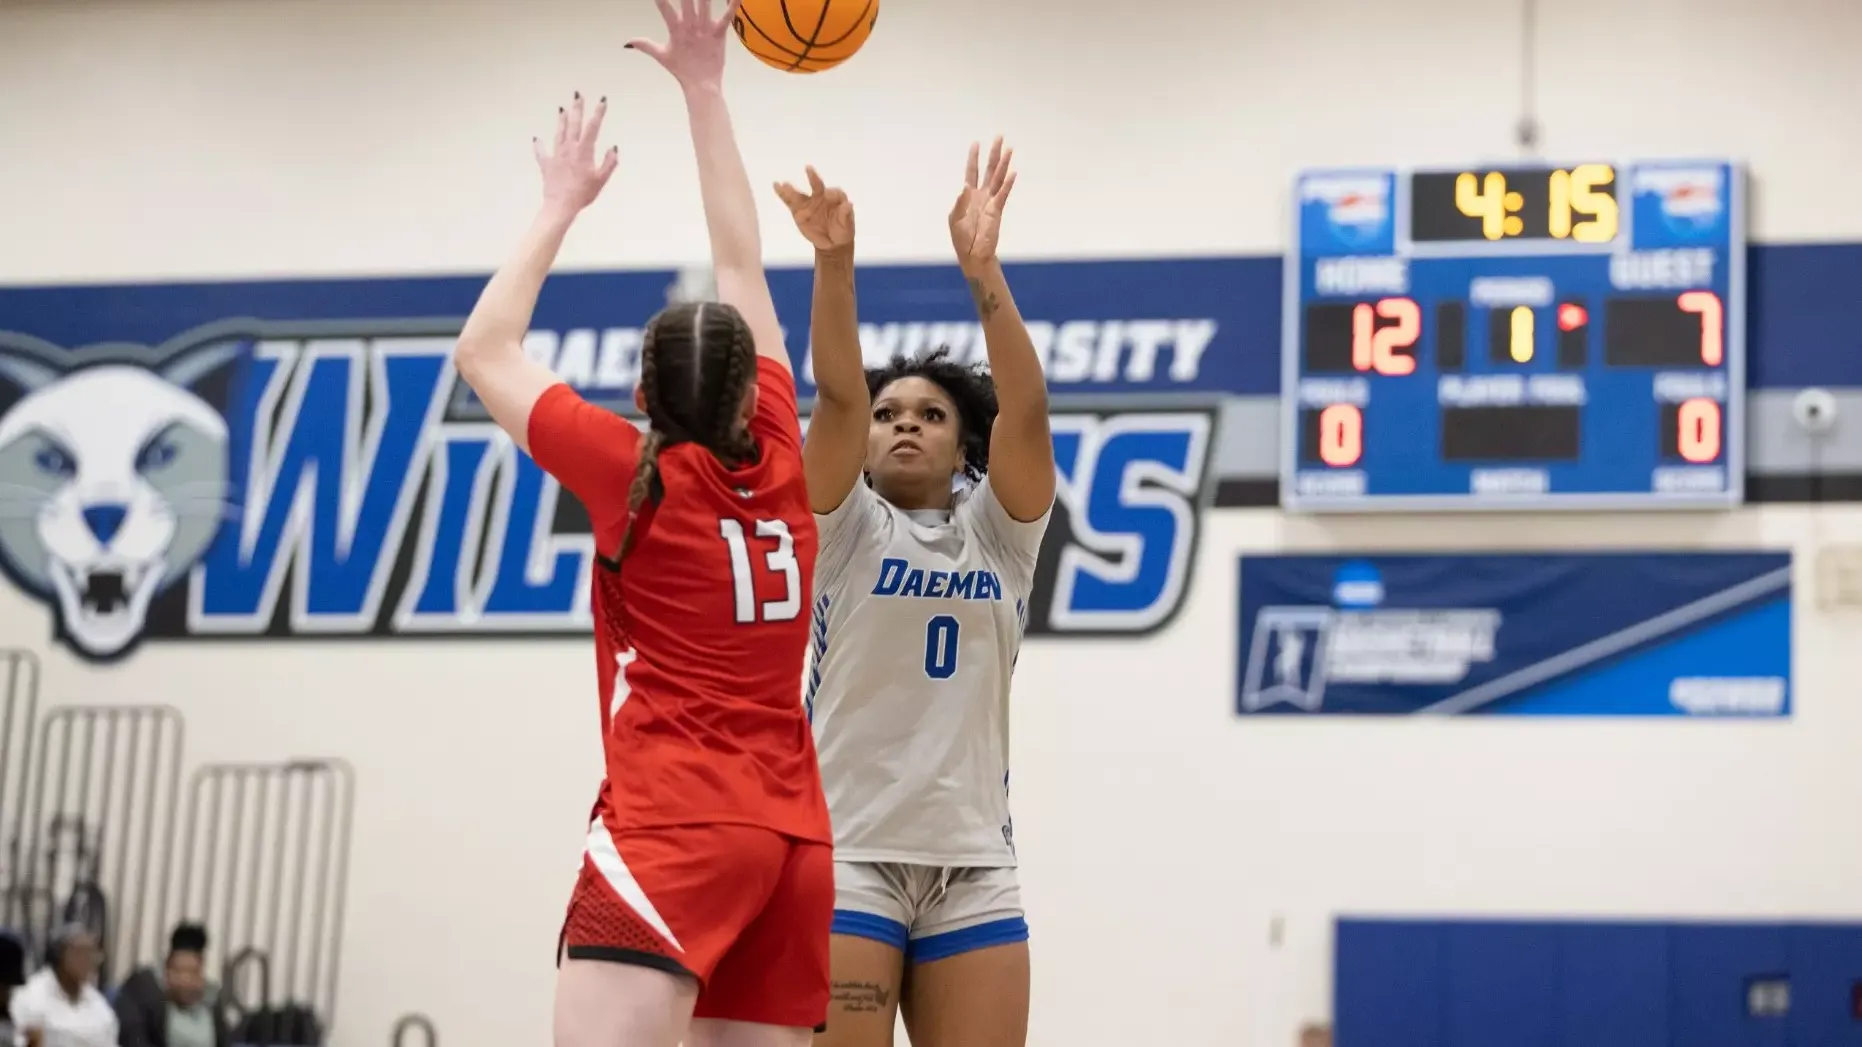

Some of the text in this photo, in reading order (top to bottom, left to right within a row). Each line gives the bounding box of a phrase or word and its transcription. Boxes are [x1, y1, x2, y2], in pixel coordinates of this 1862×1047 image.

[1455, 164, 1619, 243] 4:15
[1352, 297, 1421, 376] 12
[1510, 305, 1535, 363] 1
[1677, 291, 1723, 366] 7
[1320, 402, 1363, 466] 0
[1677, 397, 1721, 463] 0
[719, 518, 802, 623] 13
[924, 614, 961, 681] 0
